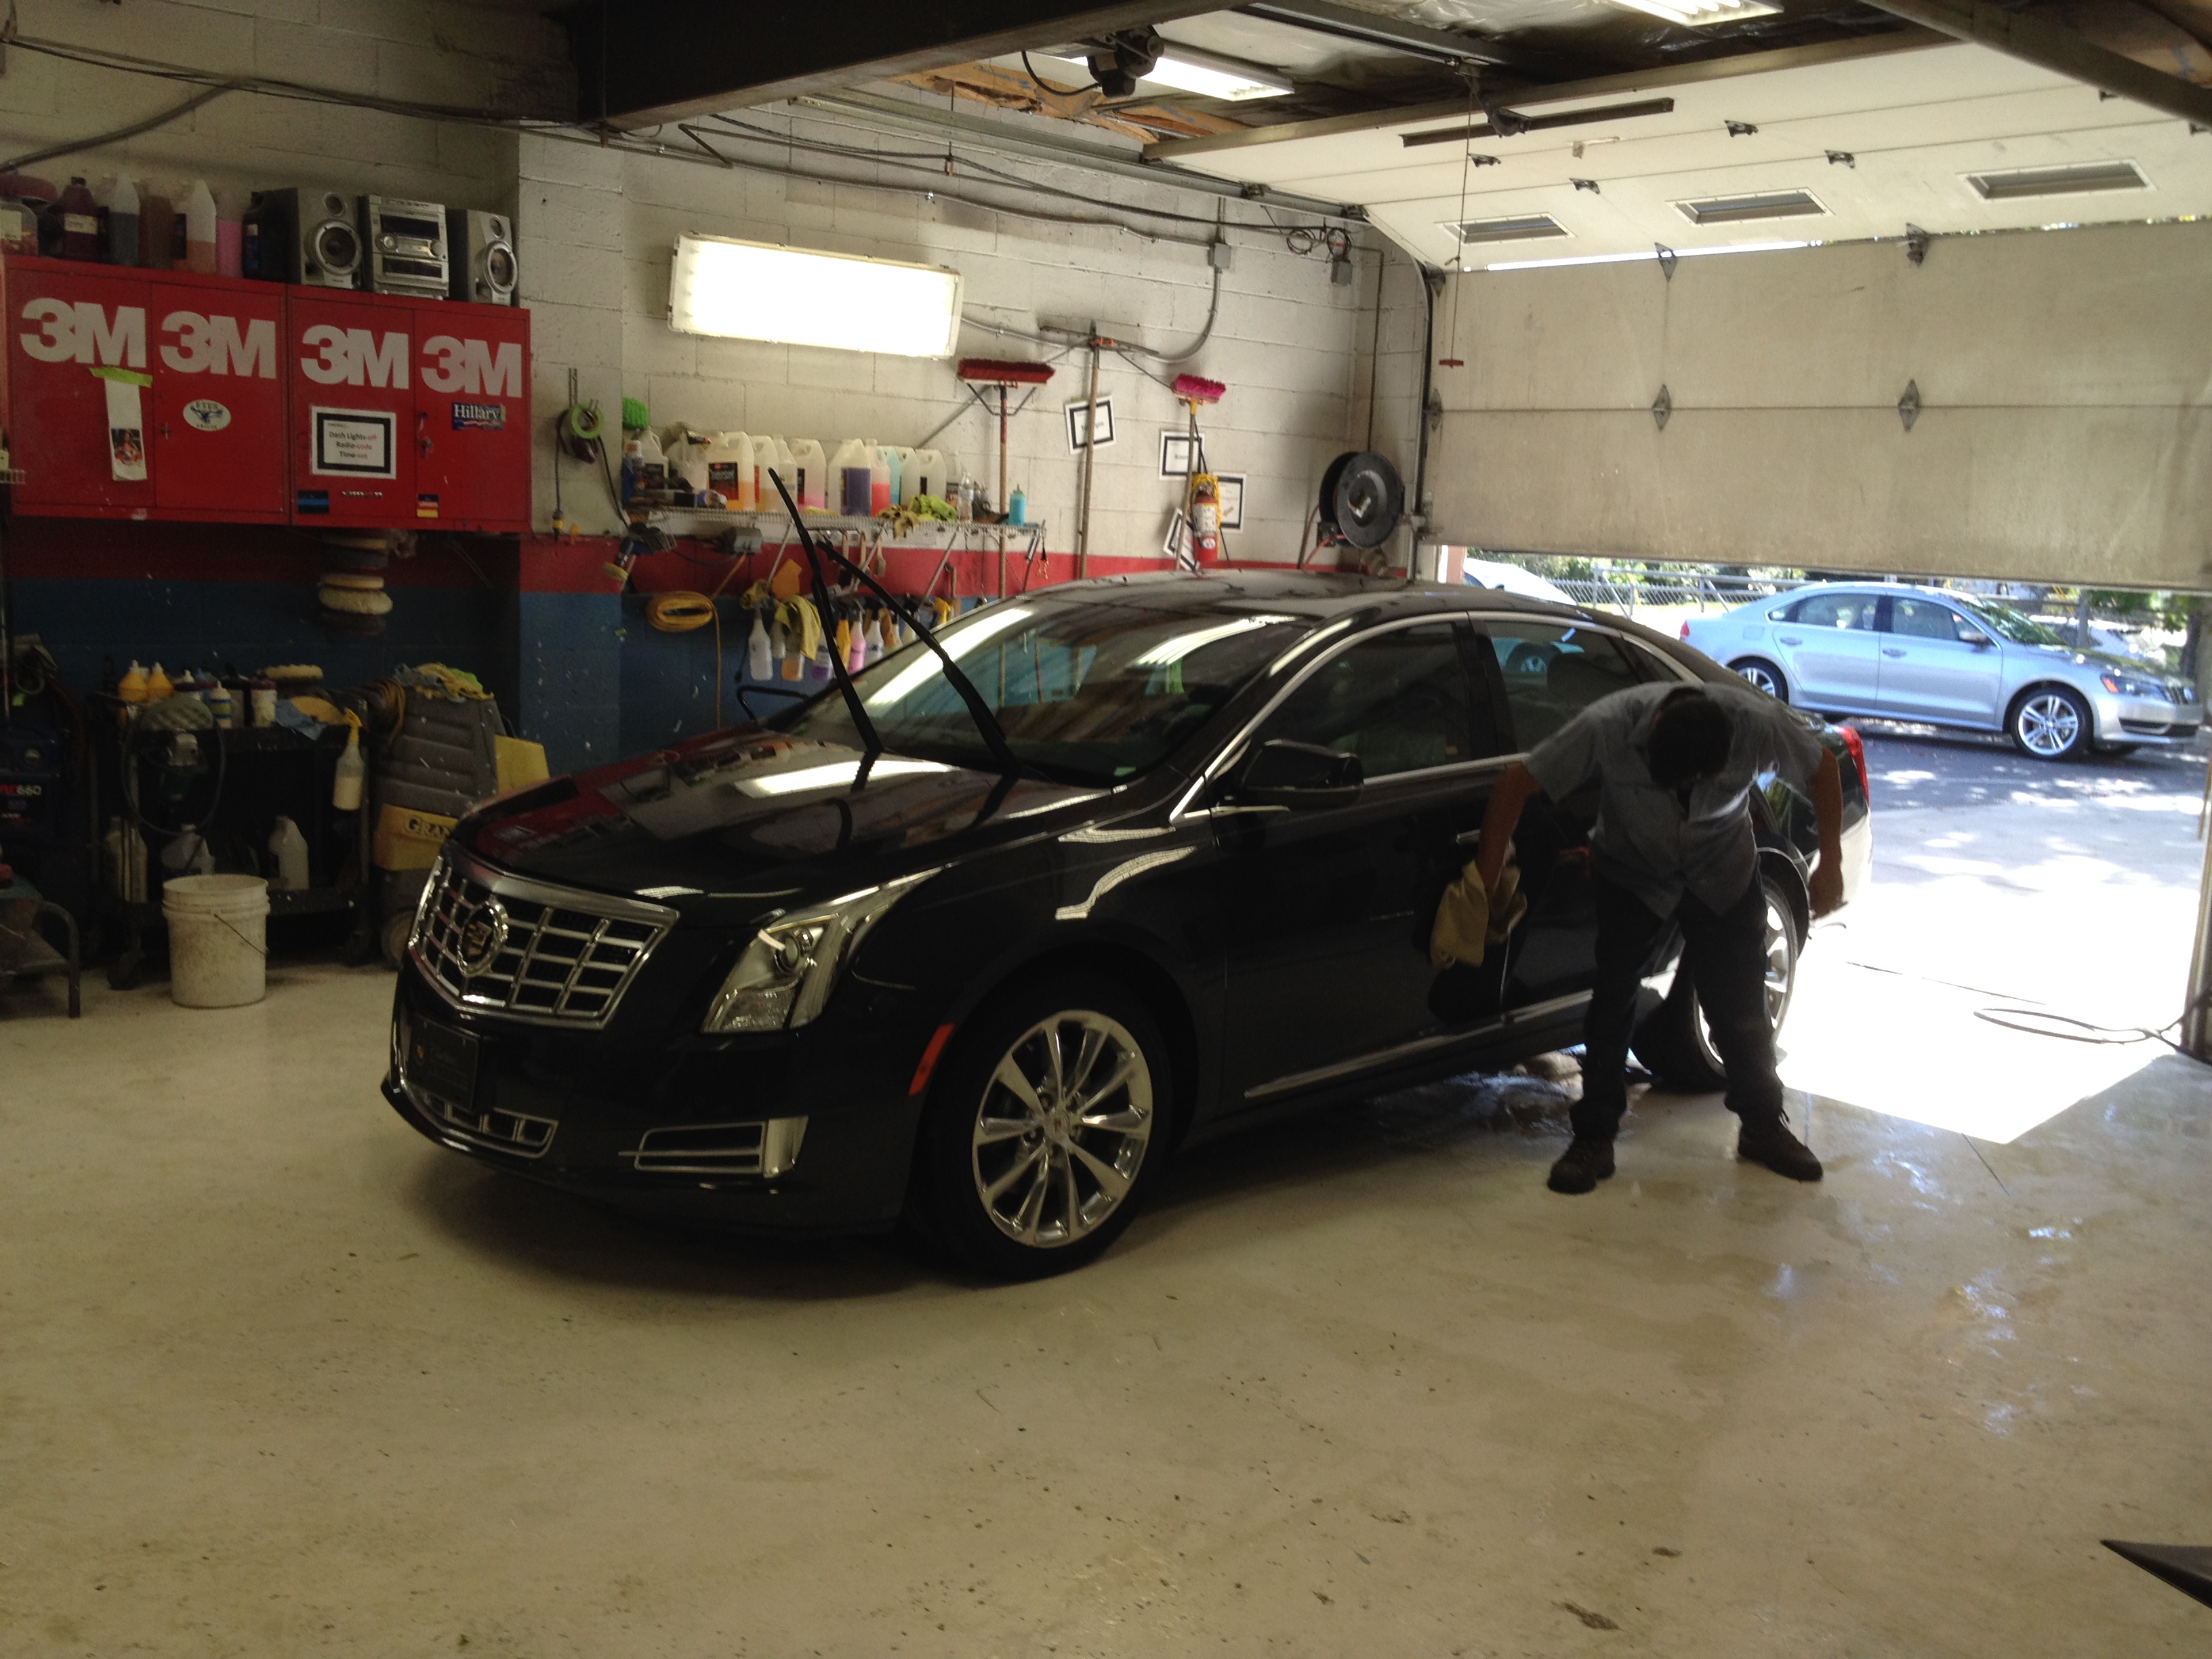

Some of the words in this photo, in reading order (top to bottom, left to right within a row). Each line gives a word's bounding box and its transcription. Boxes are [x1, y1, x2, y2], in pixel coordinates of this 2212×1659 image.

[21, 298, 148, 368] 3M
[161, 311, 276, 379] 3M
[301, 325, 409, 390] 3M
[422, 336, 522, 397] 3M
[329, 431, 346, 439] Dash
[453, 404, 500, 420] Hillary
